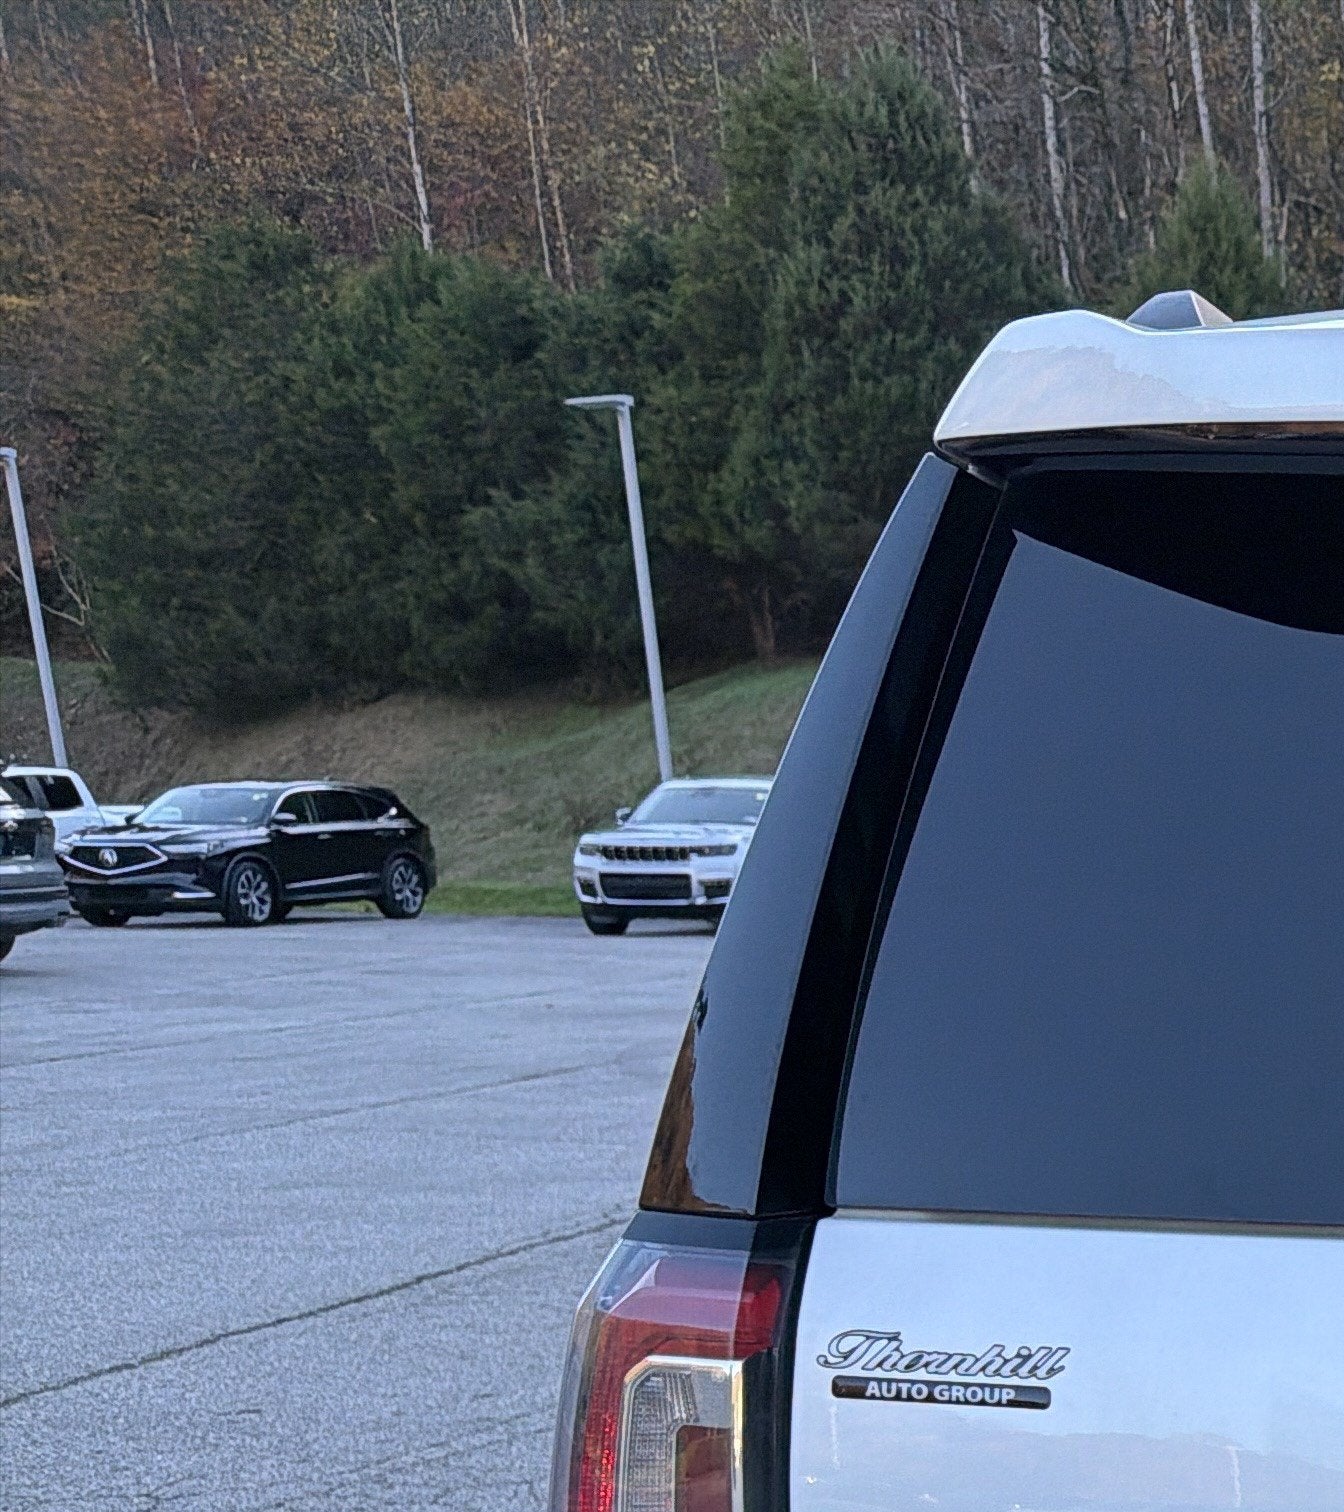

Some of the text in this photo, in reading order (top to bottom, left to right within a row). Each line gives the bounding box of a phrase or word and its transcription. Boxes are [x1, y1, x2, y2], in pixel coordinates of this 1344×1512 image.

[816, 1329, 1071, 1380] Thornhill
[865, 1380, 1016, 1404] AUTO GROUP
